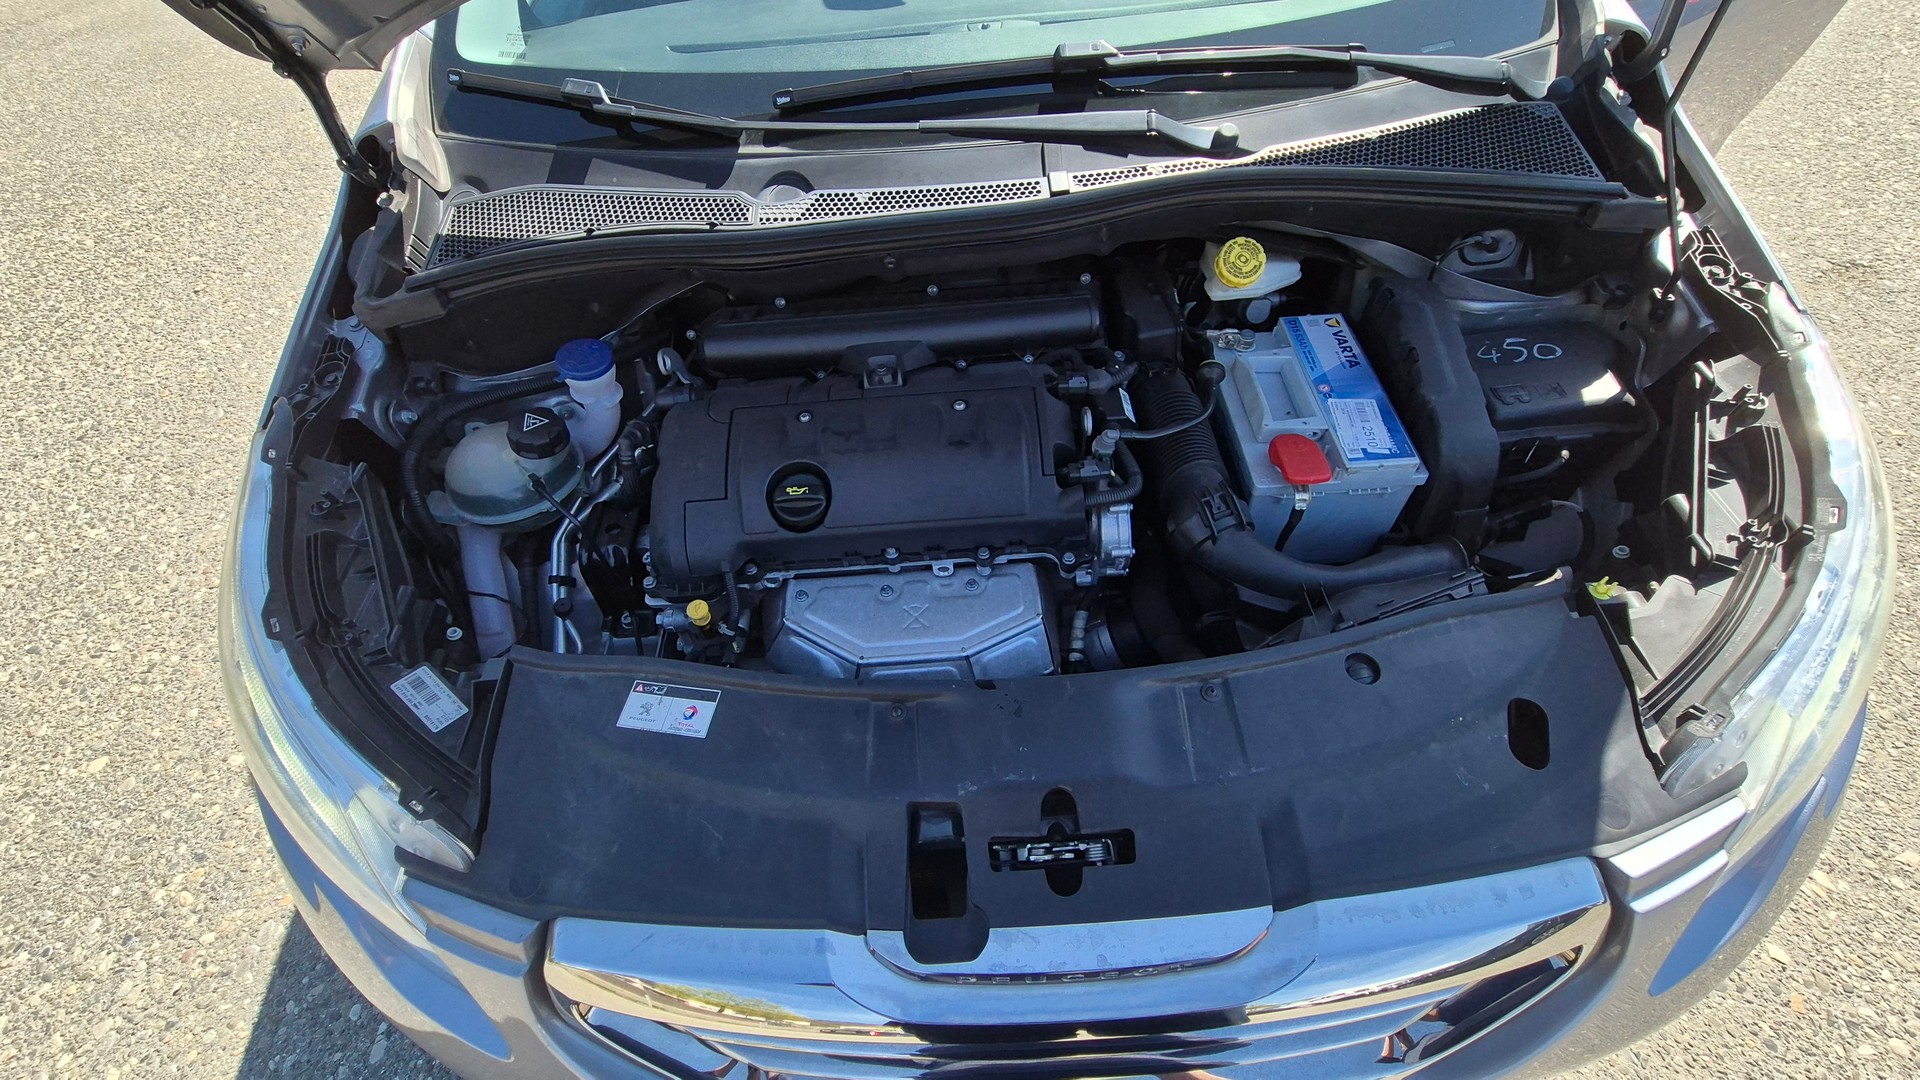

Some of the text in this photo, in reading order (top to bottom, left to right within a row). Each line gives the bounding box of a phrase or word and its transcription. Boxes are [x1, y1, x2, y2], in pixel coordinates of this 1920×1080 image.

[1332, 329, 1361, 369] VARTA
[1476, 337, 1563, 364] 450
[1361, 425, 1379, 448] 2510
[678, 721, 695, 729] TOTAL
[956, 963, 1193, 984] PEUGEOT
